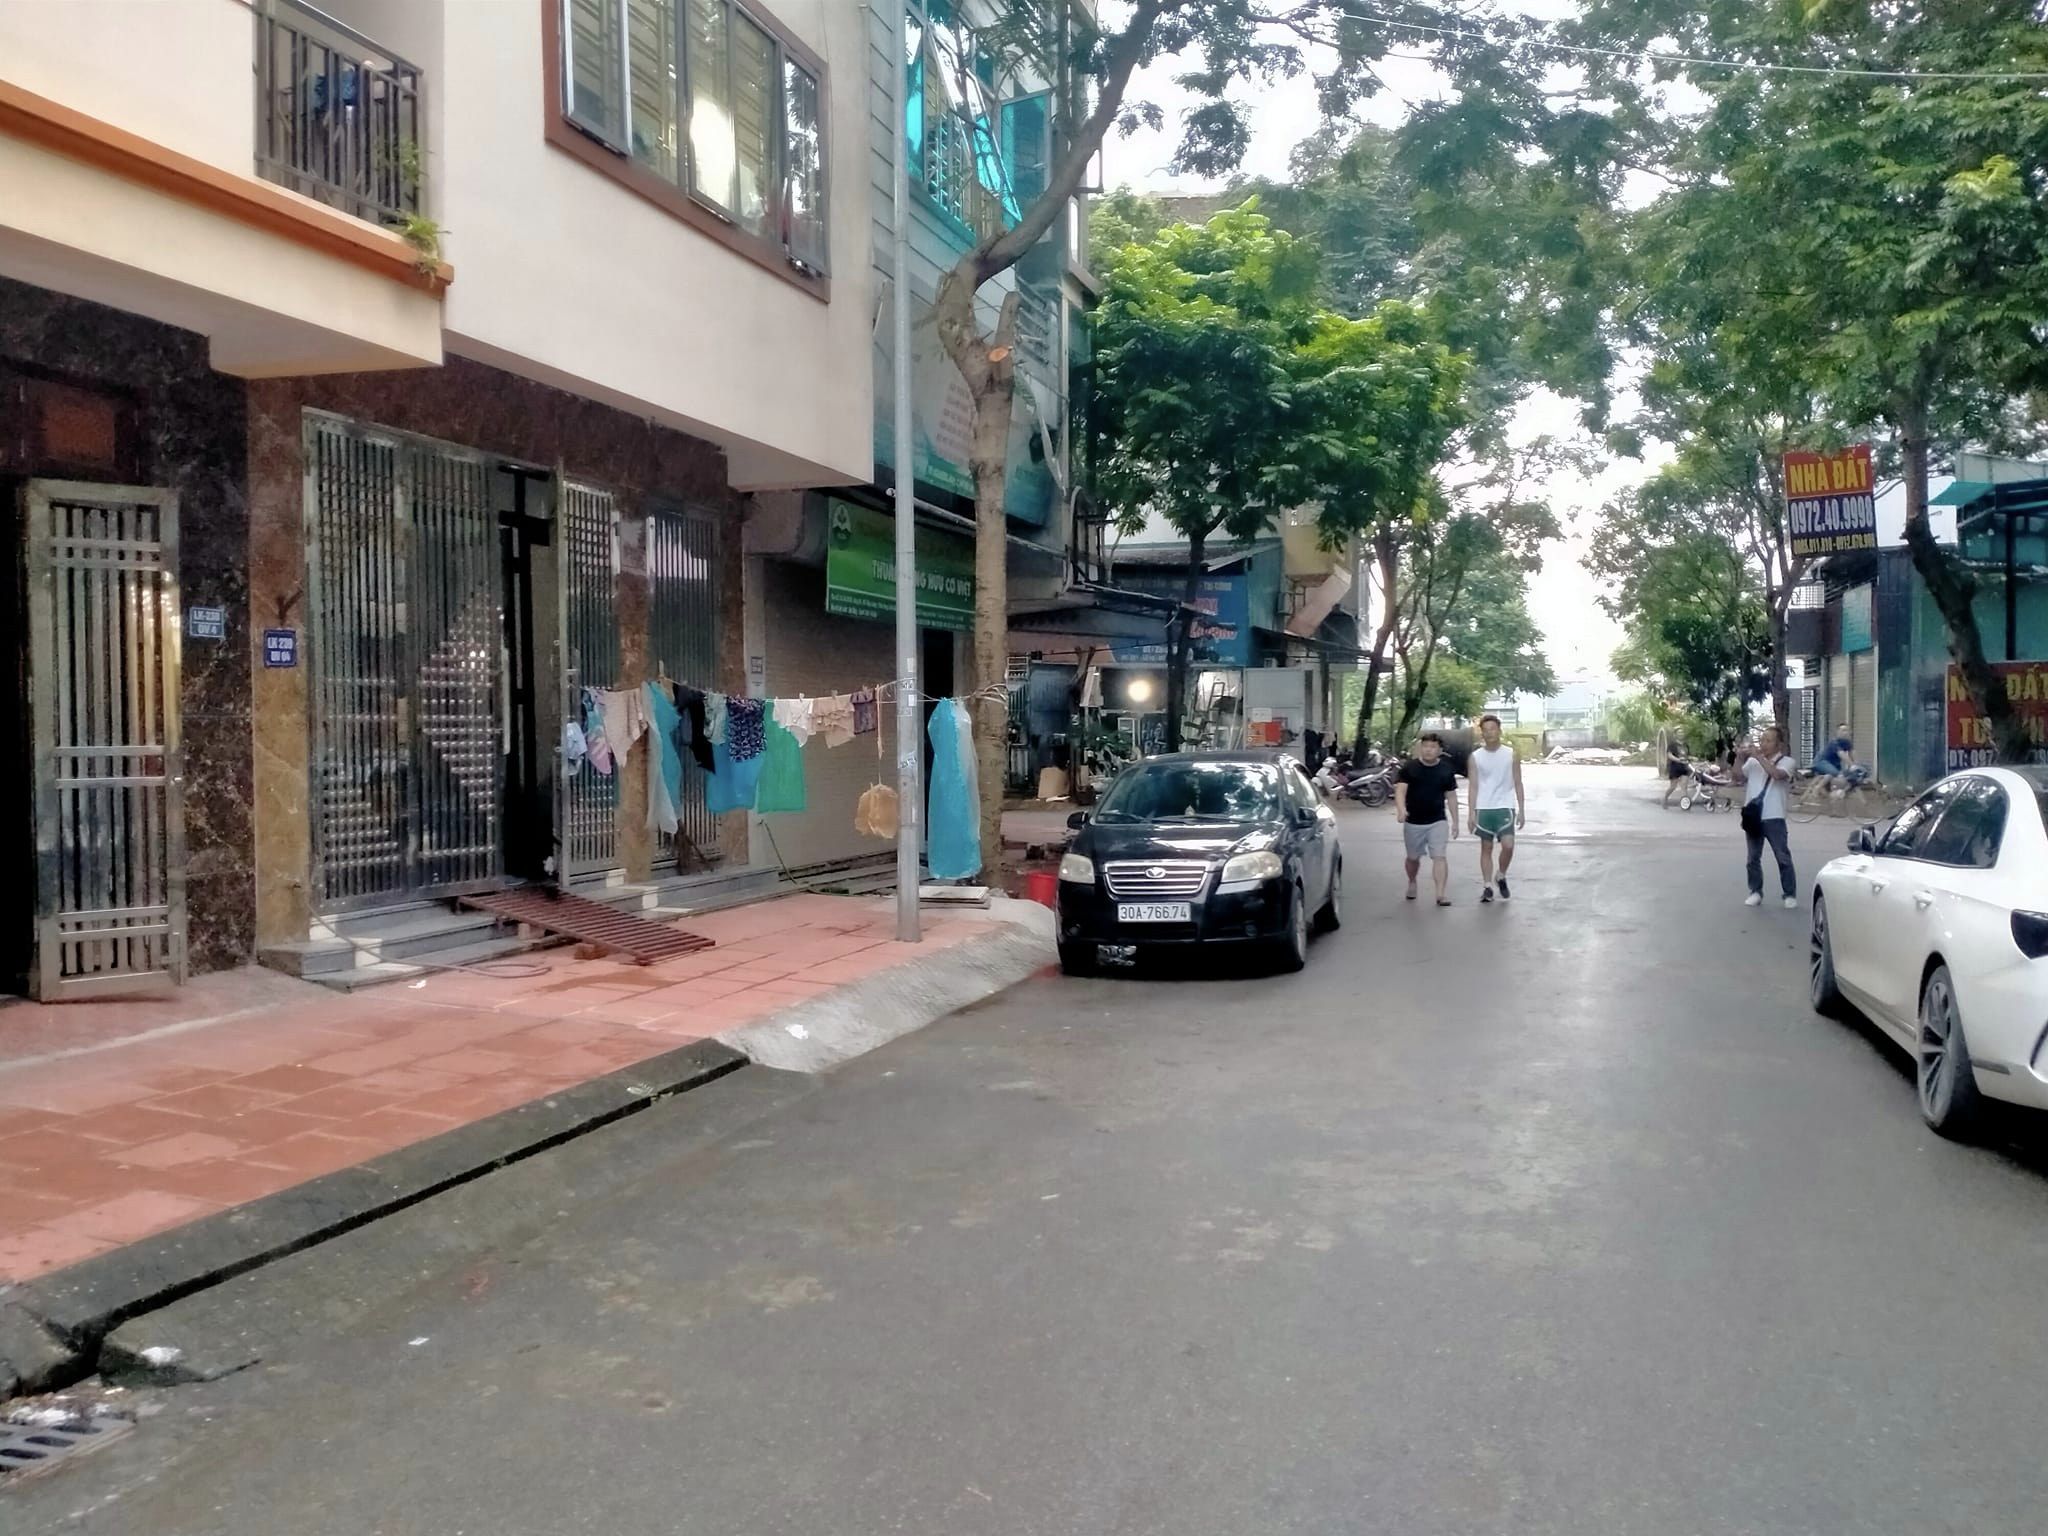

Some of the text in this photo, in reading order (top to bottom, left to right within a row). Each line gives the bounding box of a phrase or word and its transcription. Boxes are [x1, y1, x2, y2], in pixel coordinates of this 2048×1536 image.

[1789, 449, 1868, 494] NHÀ ĐẤT
[1790, 495, 1874, 534] 0972.40.9998
[267, 637, 277, 649] LK
[1120, 905, 1188, 920] 30A-766.74
